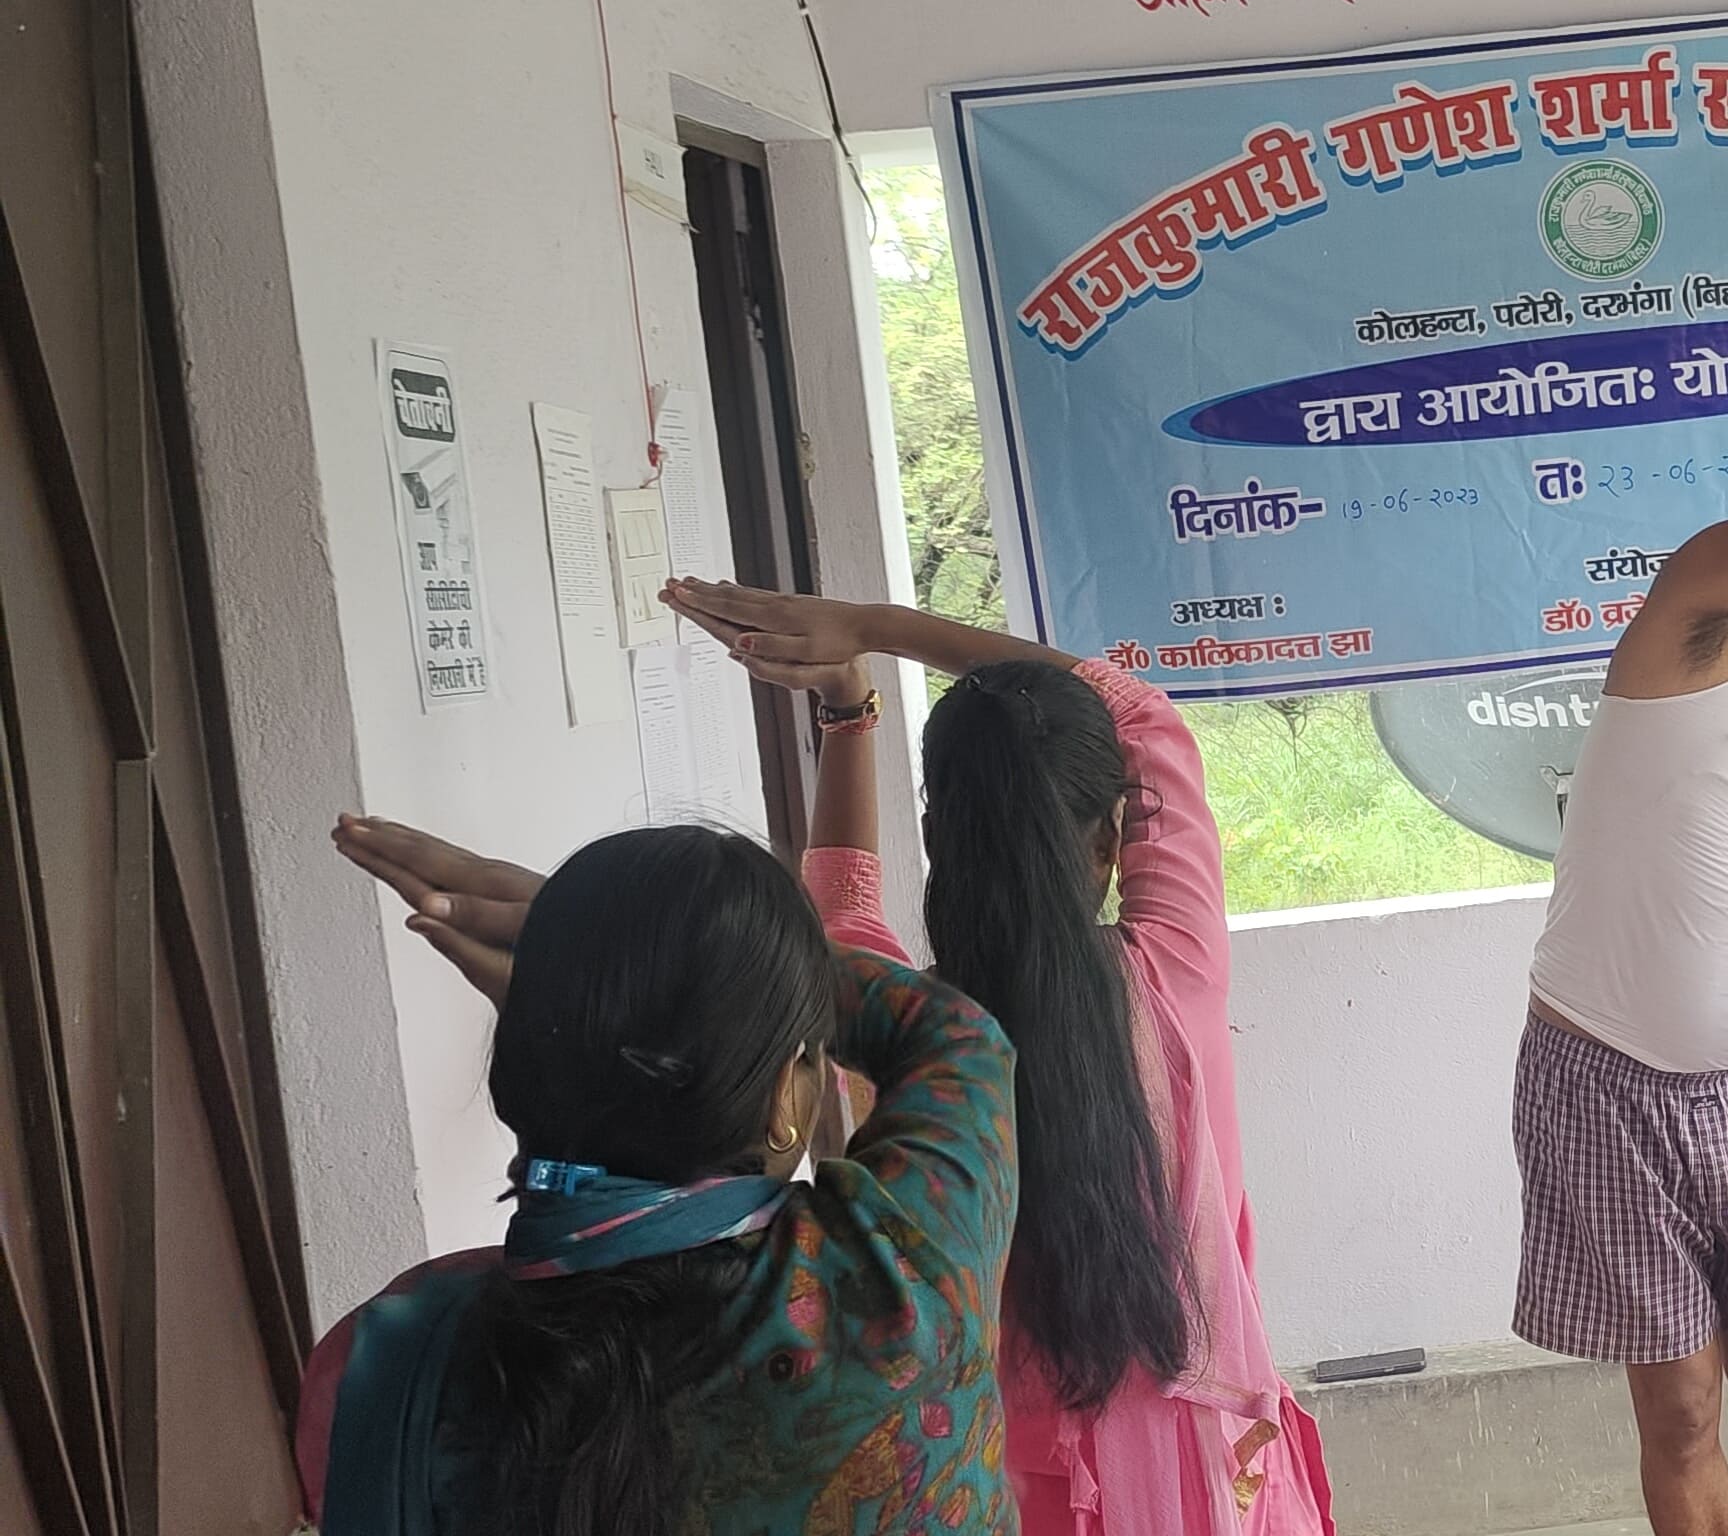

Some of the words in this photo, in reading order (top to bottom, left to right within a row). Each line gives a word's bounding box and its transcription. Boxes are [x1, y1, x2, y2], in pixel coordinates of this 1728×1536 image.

[1021, 126, 1323, 348] राजकुमारी
[1328, 84, 1517, 178] गणेश
[1533, 50, 1676, 139] शर्मा
[1494, 292, 1573, 326] पटोरी,
[1582, 283, 1672, 317] दरभंगा
[393, 378, 454, 433] चेतावनी
[1299, 392, 1402, 443] द्वारा
[1417, 363, 1655, 423] आयोजितः
[1157, 637, 1321, 669] कालिकादत्त
[1329, 630, 1372, 656] झा
